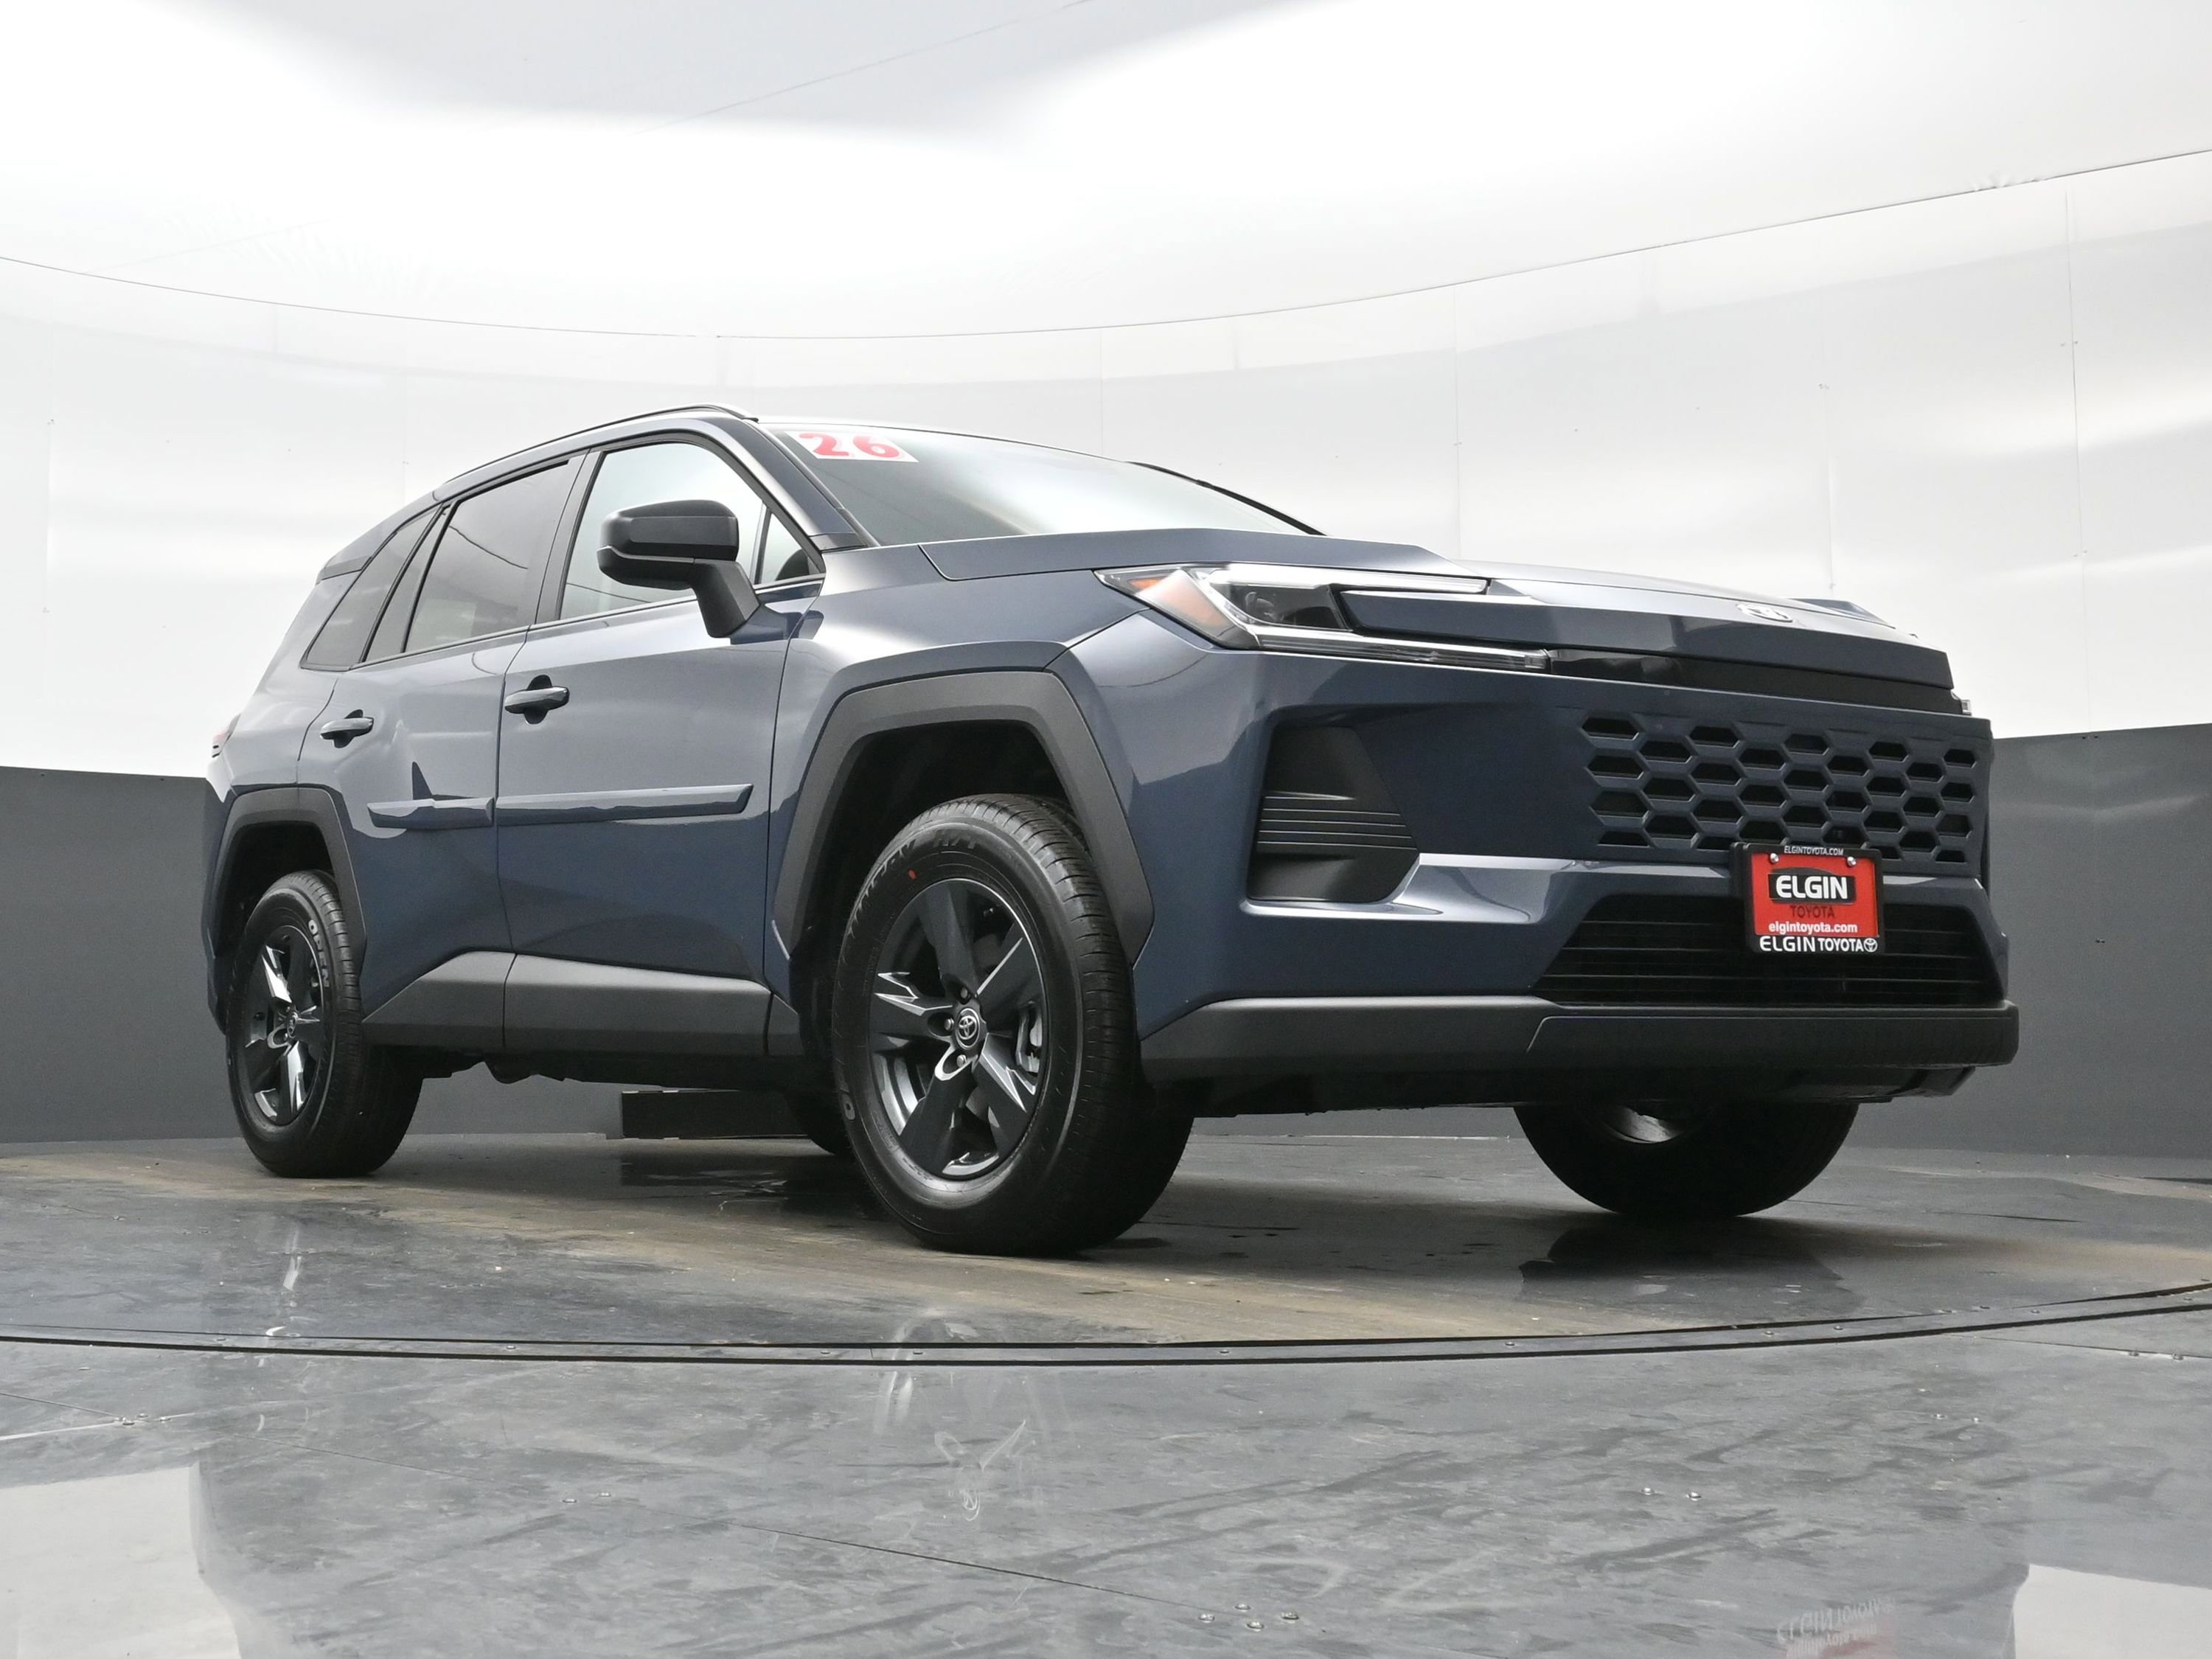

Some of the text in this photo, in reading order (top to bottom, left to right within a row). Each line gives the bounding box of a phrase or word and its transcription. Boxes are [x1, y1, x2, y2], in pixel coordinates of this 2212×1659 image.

[799, 433, 900, 458] 26
[1784, 846, 1844, 856] ELGINTOYOTA.COM
[1776, 875, 1848, 899] ELGIN
[1791, 905, 1835, 919] TOYOTA
[1769, 921, 1858, 934] elgintoyota.com
[1759, 936, 1864, 952] ELGIN TOYOTA
